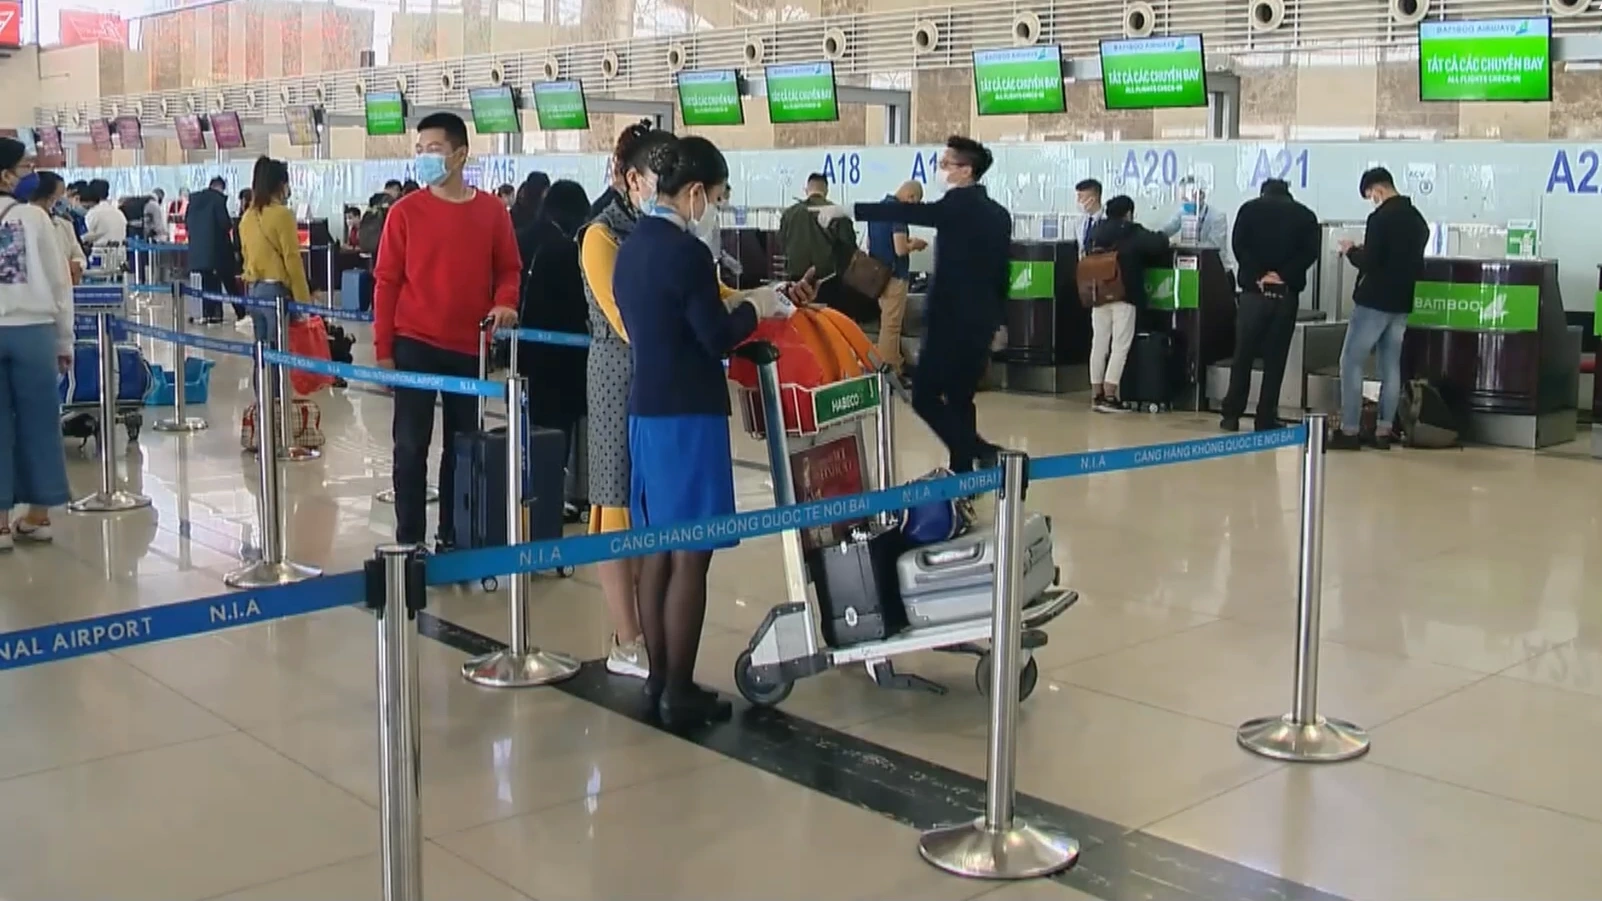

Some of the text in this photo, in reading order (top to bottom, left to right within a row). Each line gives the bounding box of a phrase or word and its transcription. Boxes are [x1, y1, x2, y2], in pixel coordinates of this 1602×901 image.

[1523, 56, 1545, 72] BAY
[492, 159, 515, 184] A15
[822, 152, 860, 185] A18
[1123, 149, 1178, 186] A20
[1251, 149, 1309, 188] A21
[1546, 149, 1602, 193] A2
[1414, 297, 1480, 312] BAMBOO
[1081, 456, 1106, 470] N.I.A
[518, 548, 562, 567] N.I.A
[209, 598, 261, 624] N.I.A
[52, 617, 153, 651] AIRPORT
